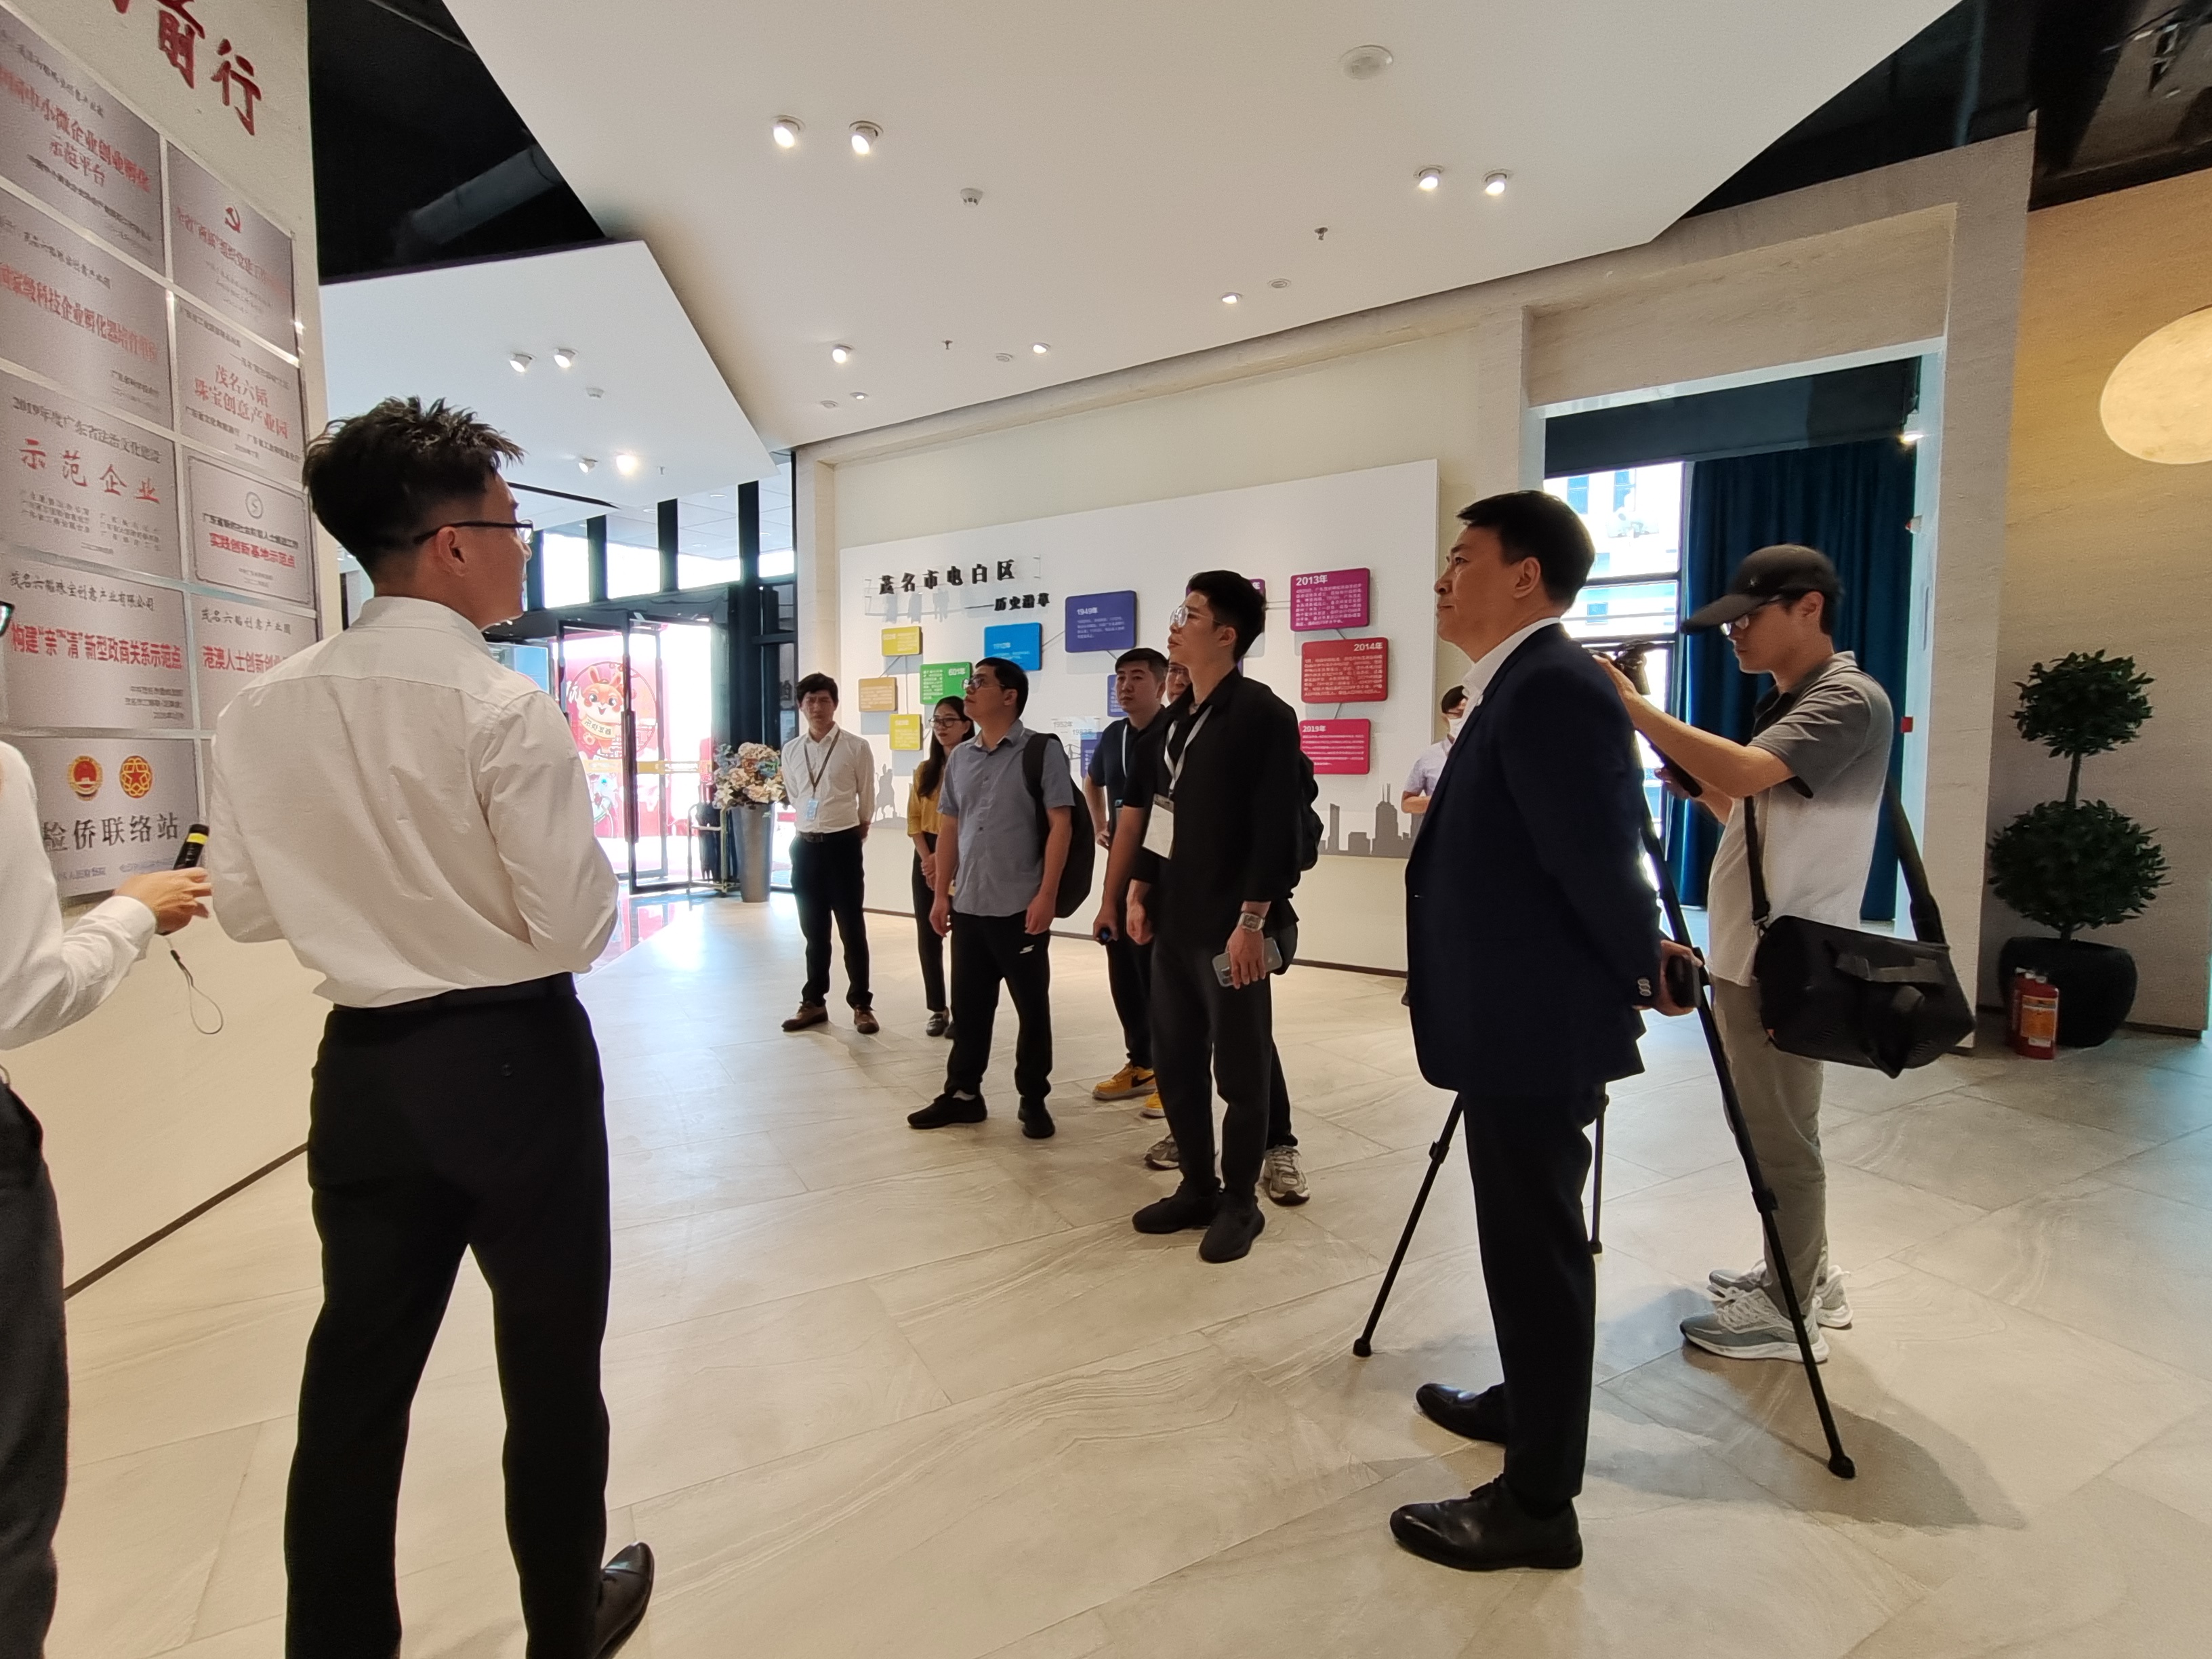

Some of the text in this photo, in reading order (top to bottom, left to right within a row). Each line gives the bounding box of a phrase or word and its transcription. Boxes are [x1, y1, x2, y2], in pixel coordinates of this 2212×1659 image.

[112, 0, 262, 136] 前行
[19, 438, 161, 504] 示范企业
[878, 559, 1015, 595] 茂名市电白区
[1296, 575, 1328, 586] 2013年
[1353, 642, 1383, 652] 2014年
